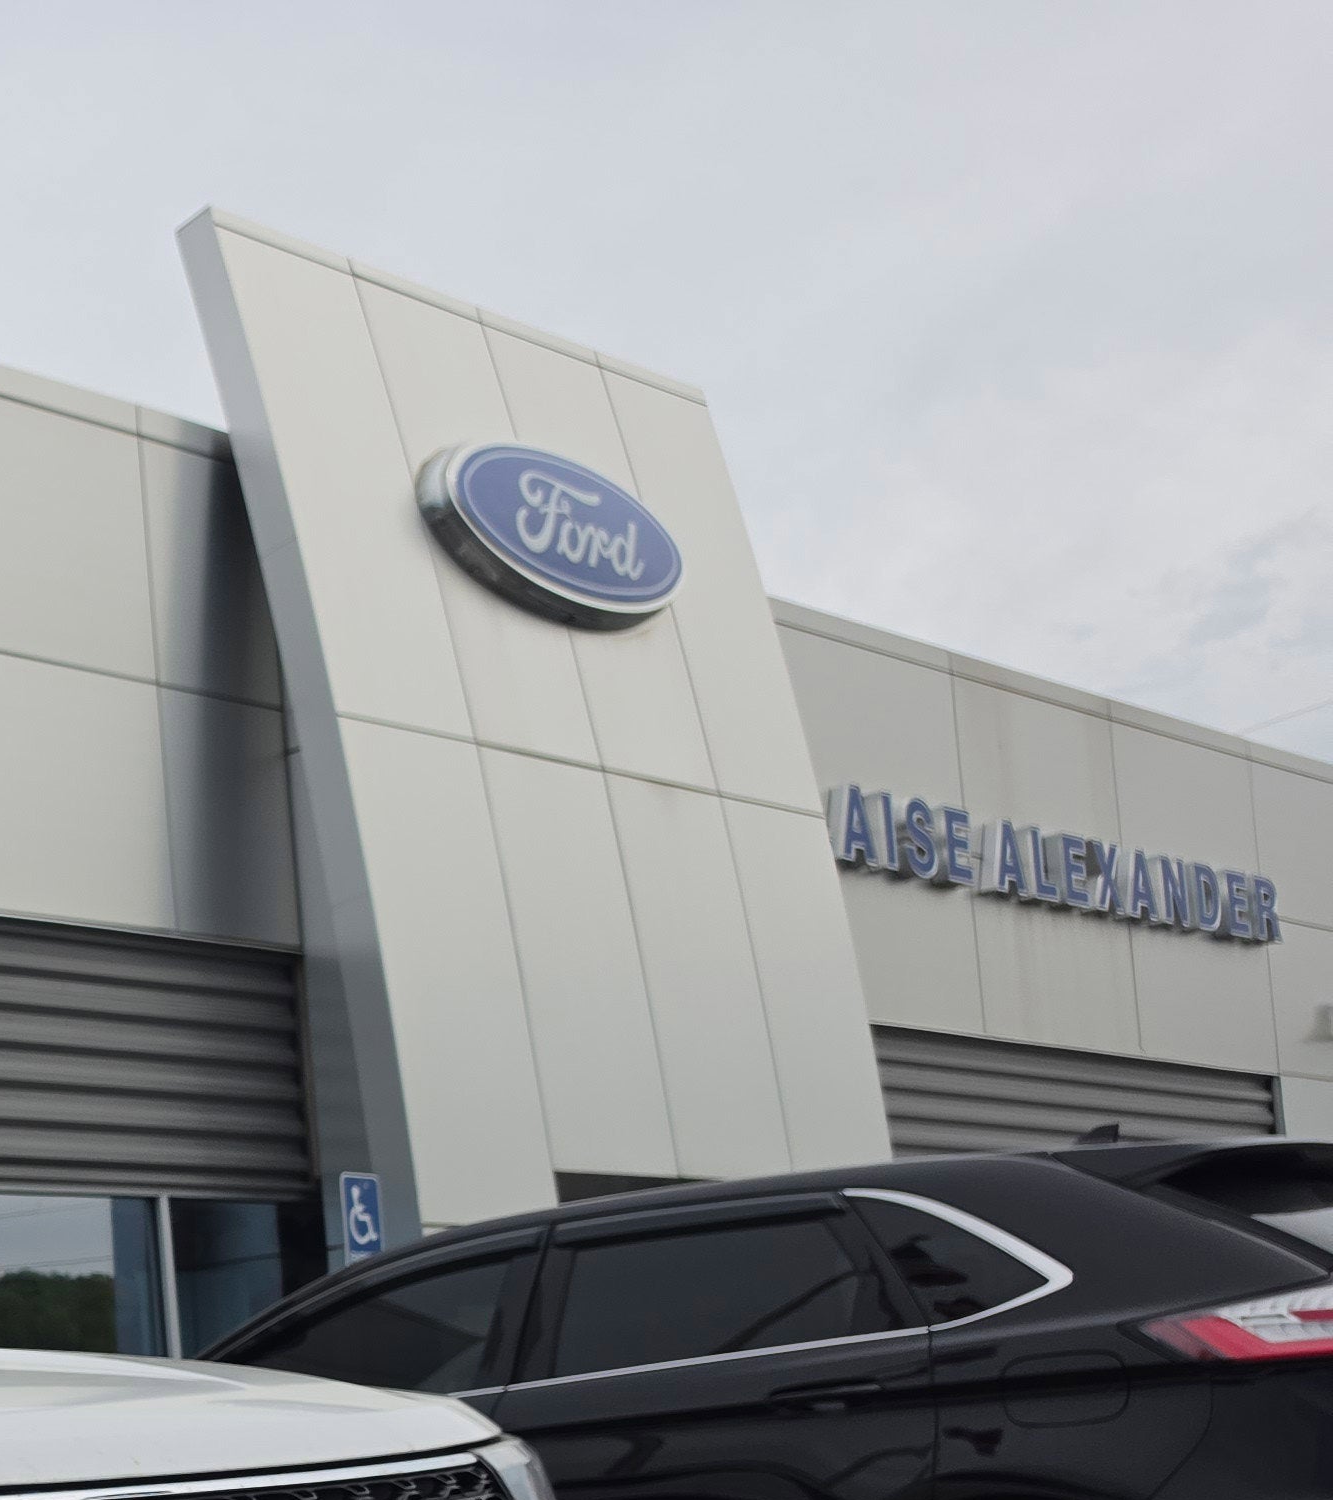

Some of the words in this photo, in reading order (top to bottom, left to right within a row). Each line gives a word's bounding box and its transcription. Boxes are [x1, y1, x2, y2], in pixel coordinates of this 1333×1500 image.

[515, 469, 645, 581] Ford
[837, 783, 975, 887] AISE
[993, 818, 1282, 943] ALEXANDER
